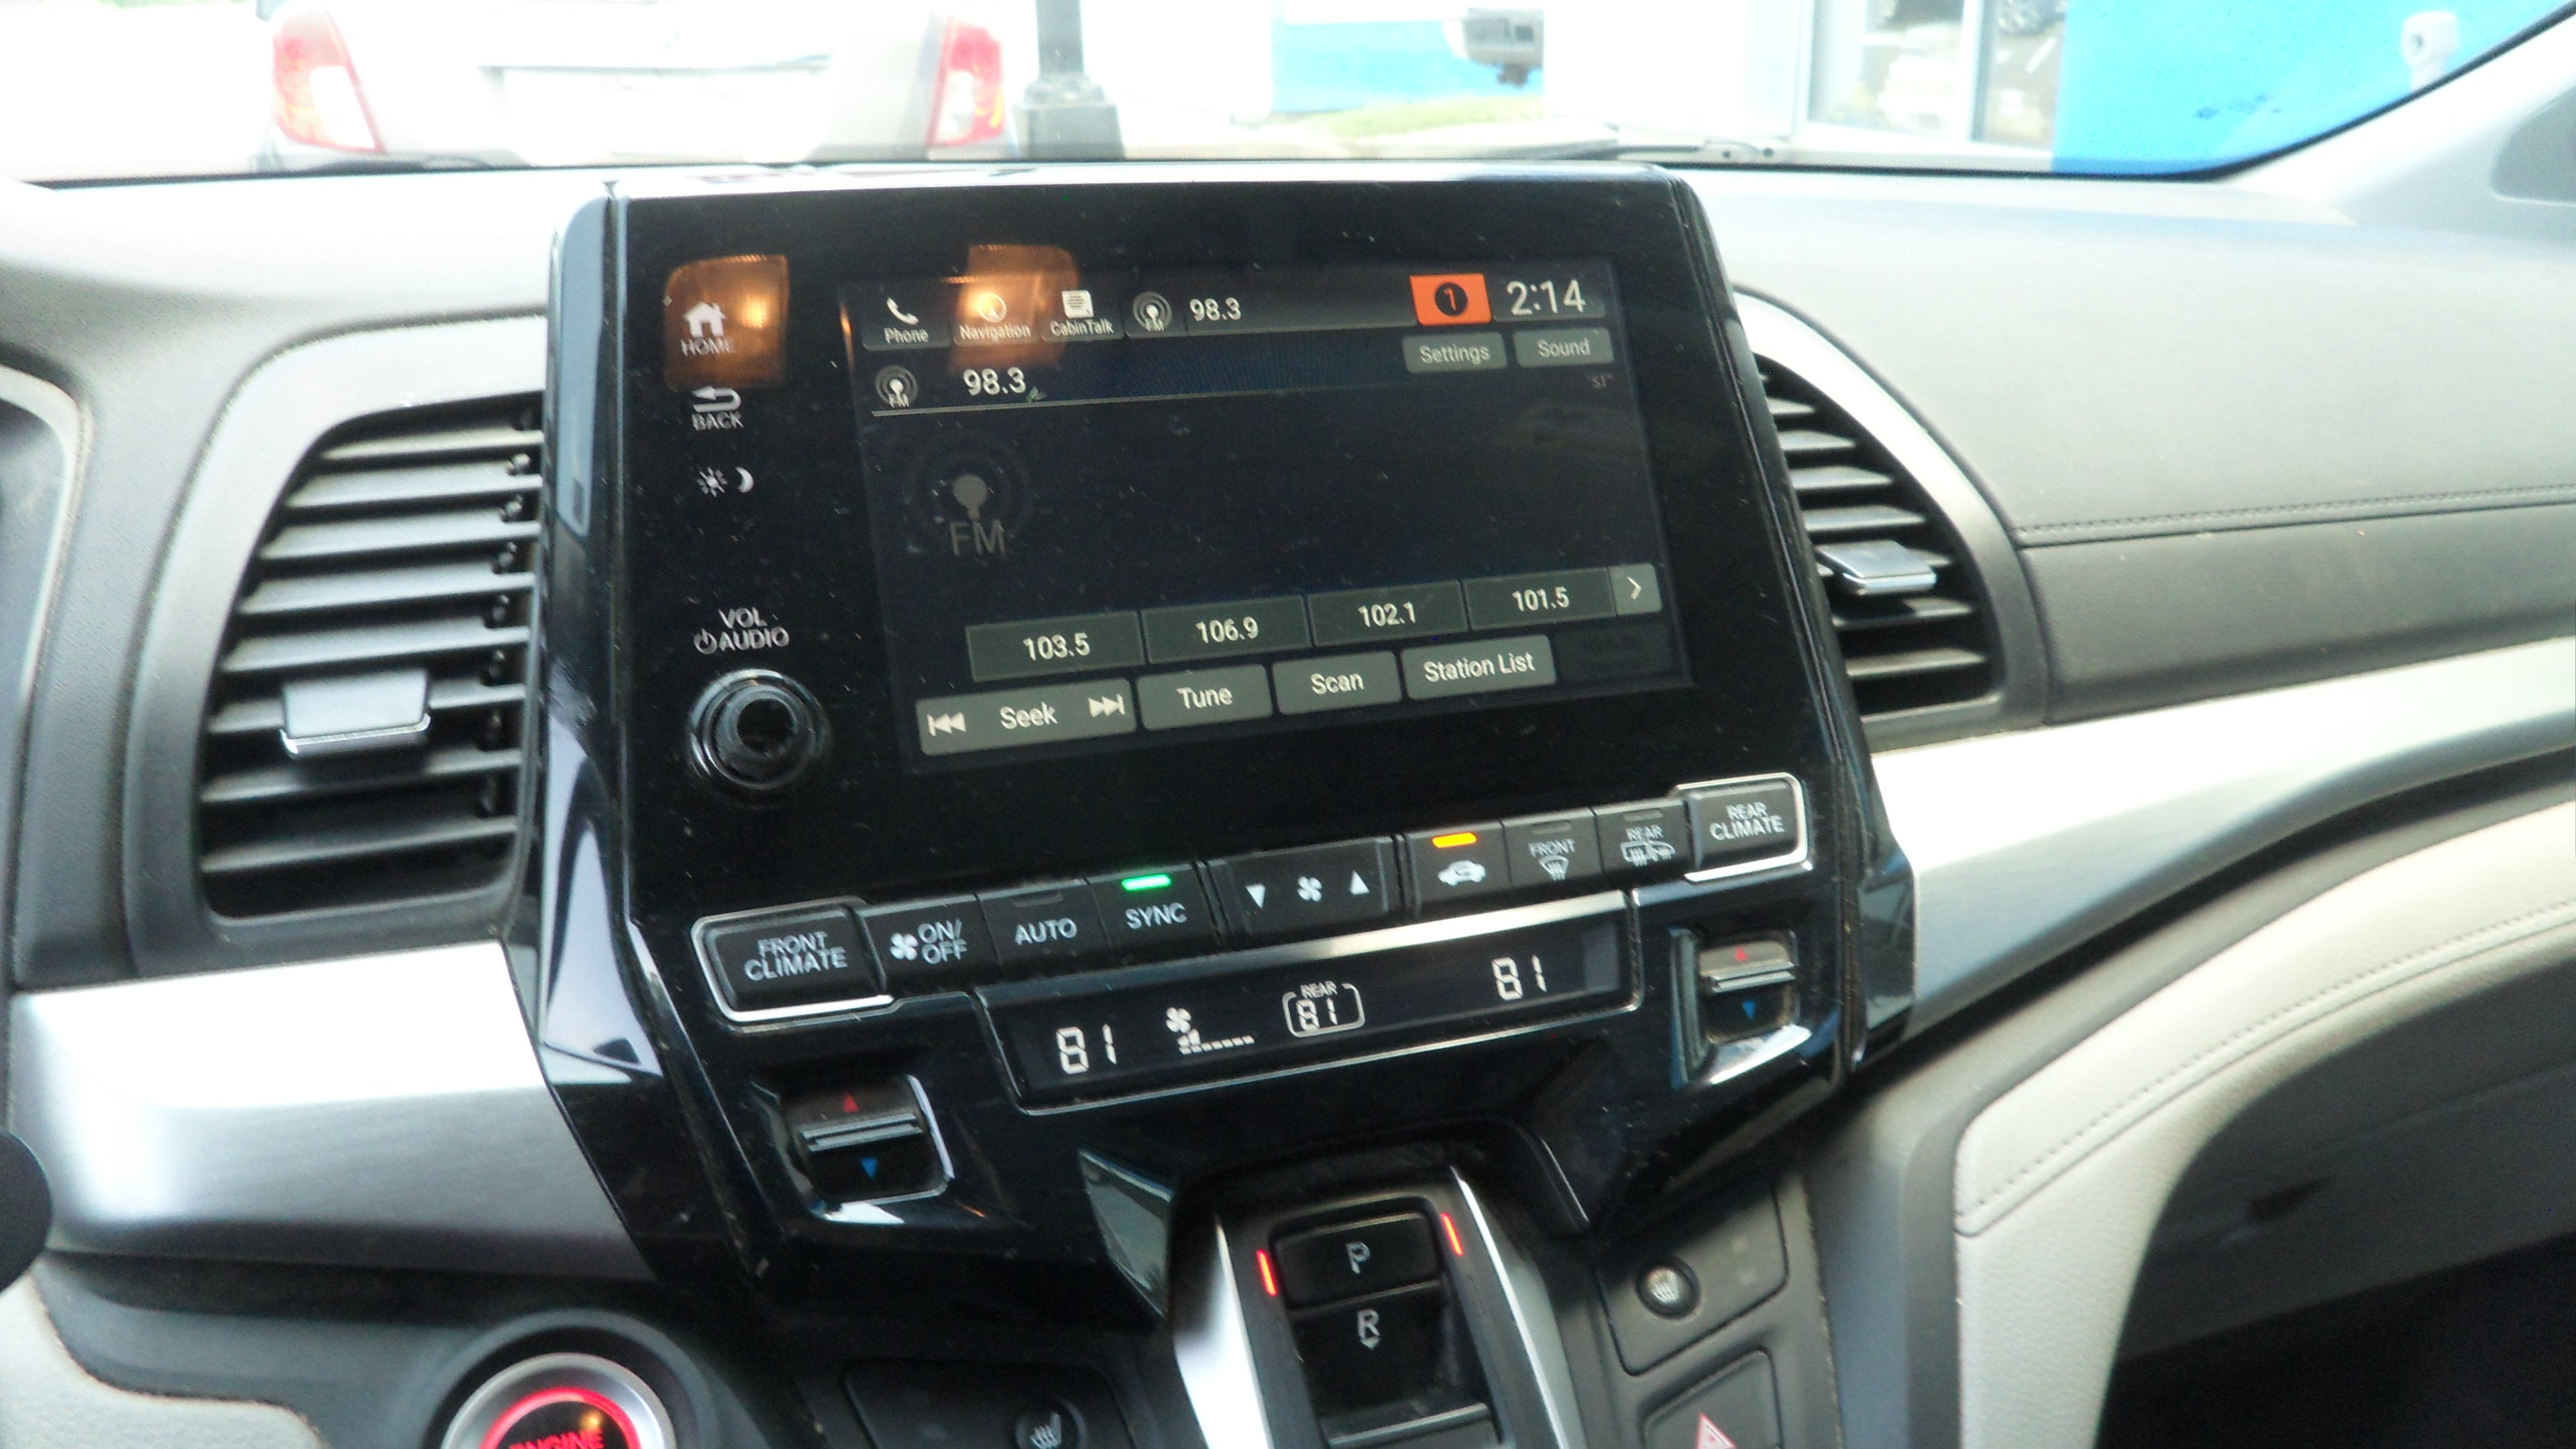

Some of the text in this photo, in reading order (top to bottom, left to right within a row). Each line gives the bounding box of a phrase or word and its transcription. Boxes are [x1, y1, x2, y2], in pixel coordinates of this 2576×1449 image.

[1189, 297, 1242, 322] 98.3
[1505, 279, 1587, 316] 2:14
[883, 326, 929, 345] Phone
[959, 322, 1031, 343] Navigation
[1049, 318, 1114, 336] CabinTalk
[680, 337, 736, 357] HOME
[1419, 343, 1491, 366] Settings
[1538, 337, 1591, 359] Sound
[963, 366, 1026, 396] 98.3
[888, 393, 910, 408] FM
[691, 411, 744, 431] BACK
[949, 518, 1006, 556] FM
[1512, 586, 1570, 612] 101.5
[718, 607, 768, 629] VOL
[1358, 601, 1416, 628] 102.1
[718, 627, 790, 653] AUDIO
[1195, 616, 1259, 643] 106.9
[1022, 632, 1090, 661] 103.5
[1424, 651, 1536, 683] Station List
[1310, 670, 1364, 695] Scan
[1177, 684, 1233, 710] Tune
[1000, 702, 1059, 731] Seek
[1725, 801, 1768, 821] REAR
[1625, 824, 1664, 842] REAR
[1709, 814, 1785, 842] CLIMATE
[1527, 838, 1576, 858] FRONT
[1125, 902, 1189, 930] SYNC
[757, 930, 828, 959] FRONT
[1014, 917, 1078, 946] AUTO
[743, 946, 849, 982] CLIMATE
[921, 939, 967, 965] OFF
[1299, 979, 1339, 998] REAR
[1491, 954, 1548, 1002] 81
[1295, 998, 1338, 1032] 81
[1055, 1023, 1118, 1075] 81
[1345, 1240, 1371, 1275] P
[1356, 1308, 1381, 1340] R
[508, 1429, 604, 1449] GINE
